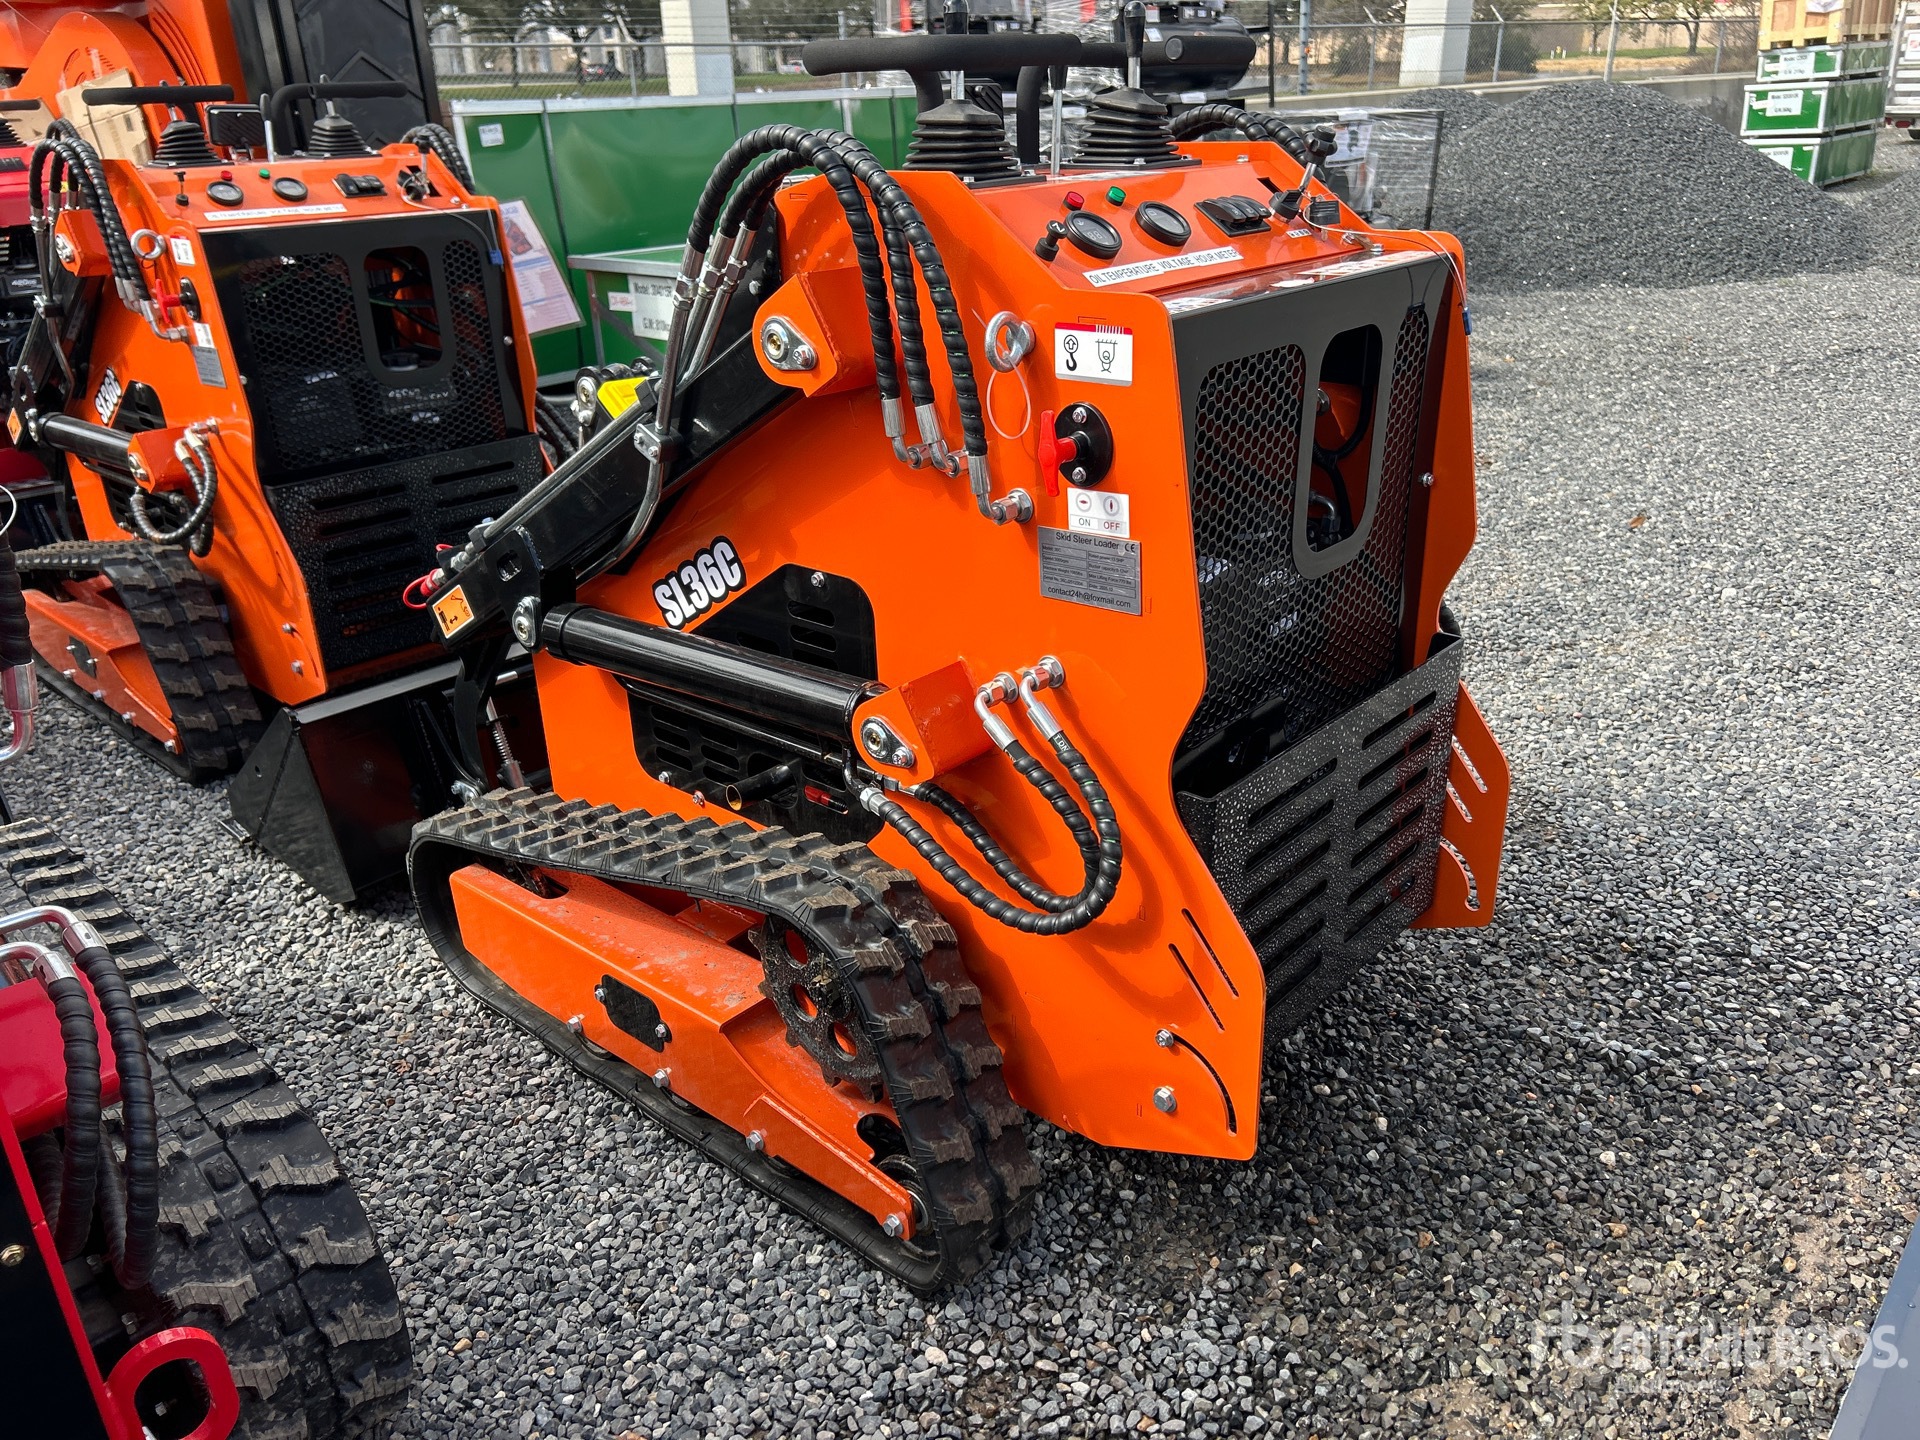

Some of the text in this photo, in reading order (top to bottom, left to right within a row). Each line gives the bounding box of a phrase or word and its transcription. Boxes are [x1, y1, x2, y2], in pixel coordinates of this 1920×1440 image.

[1157, 257, 1195, 270] VOLTAGE
[1195, 252, 1216, 263] HOUR
[1078, 517, 1120, 531] ON OFF
[1055, 532, 1072, 542] Skid
[1073, 533, 1092, 545] Steer
[1093, 538, 1119, 550] Loader
[654, 541, 742, 627] SL36C
[1047, 585, 1131, 609] contact24h@foxmail.com
